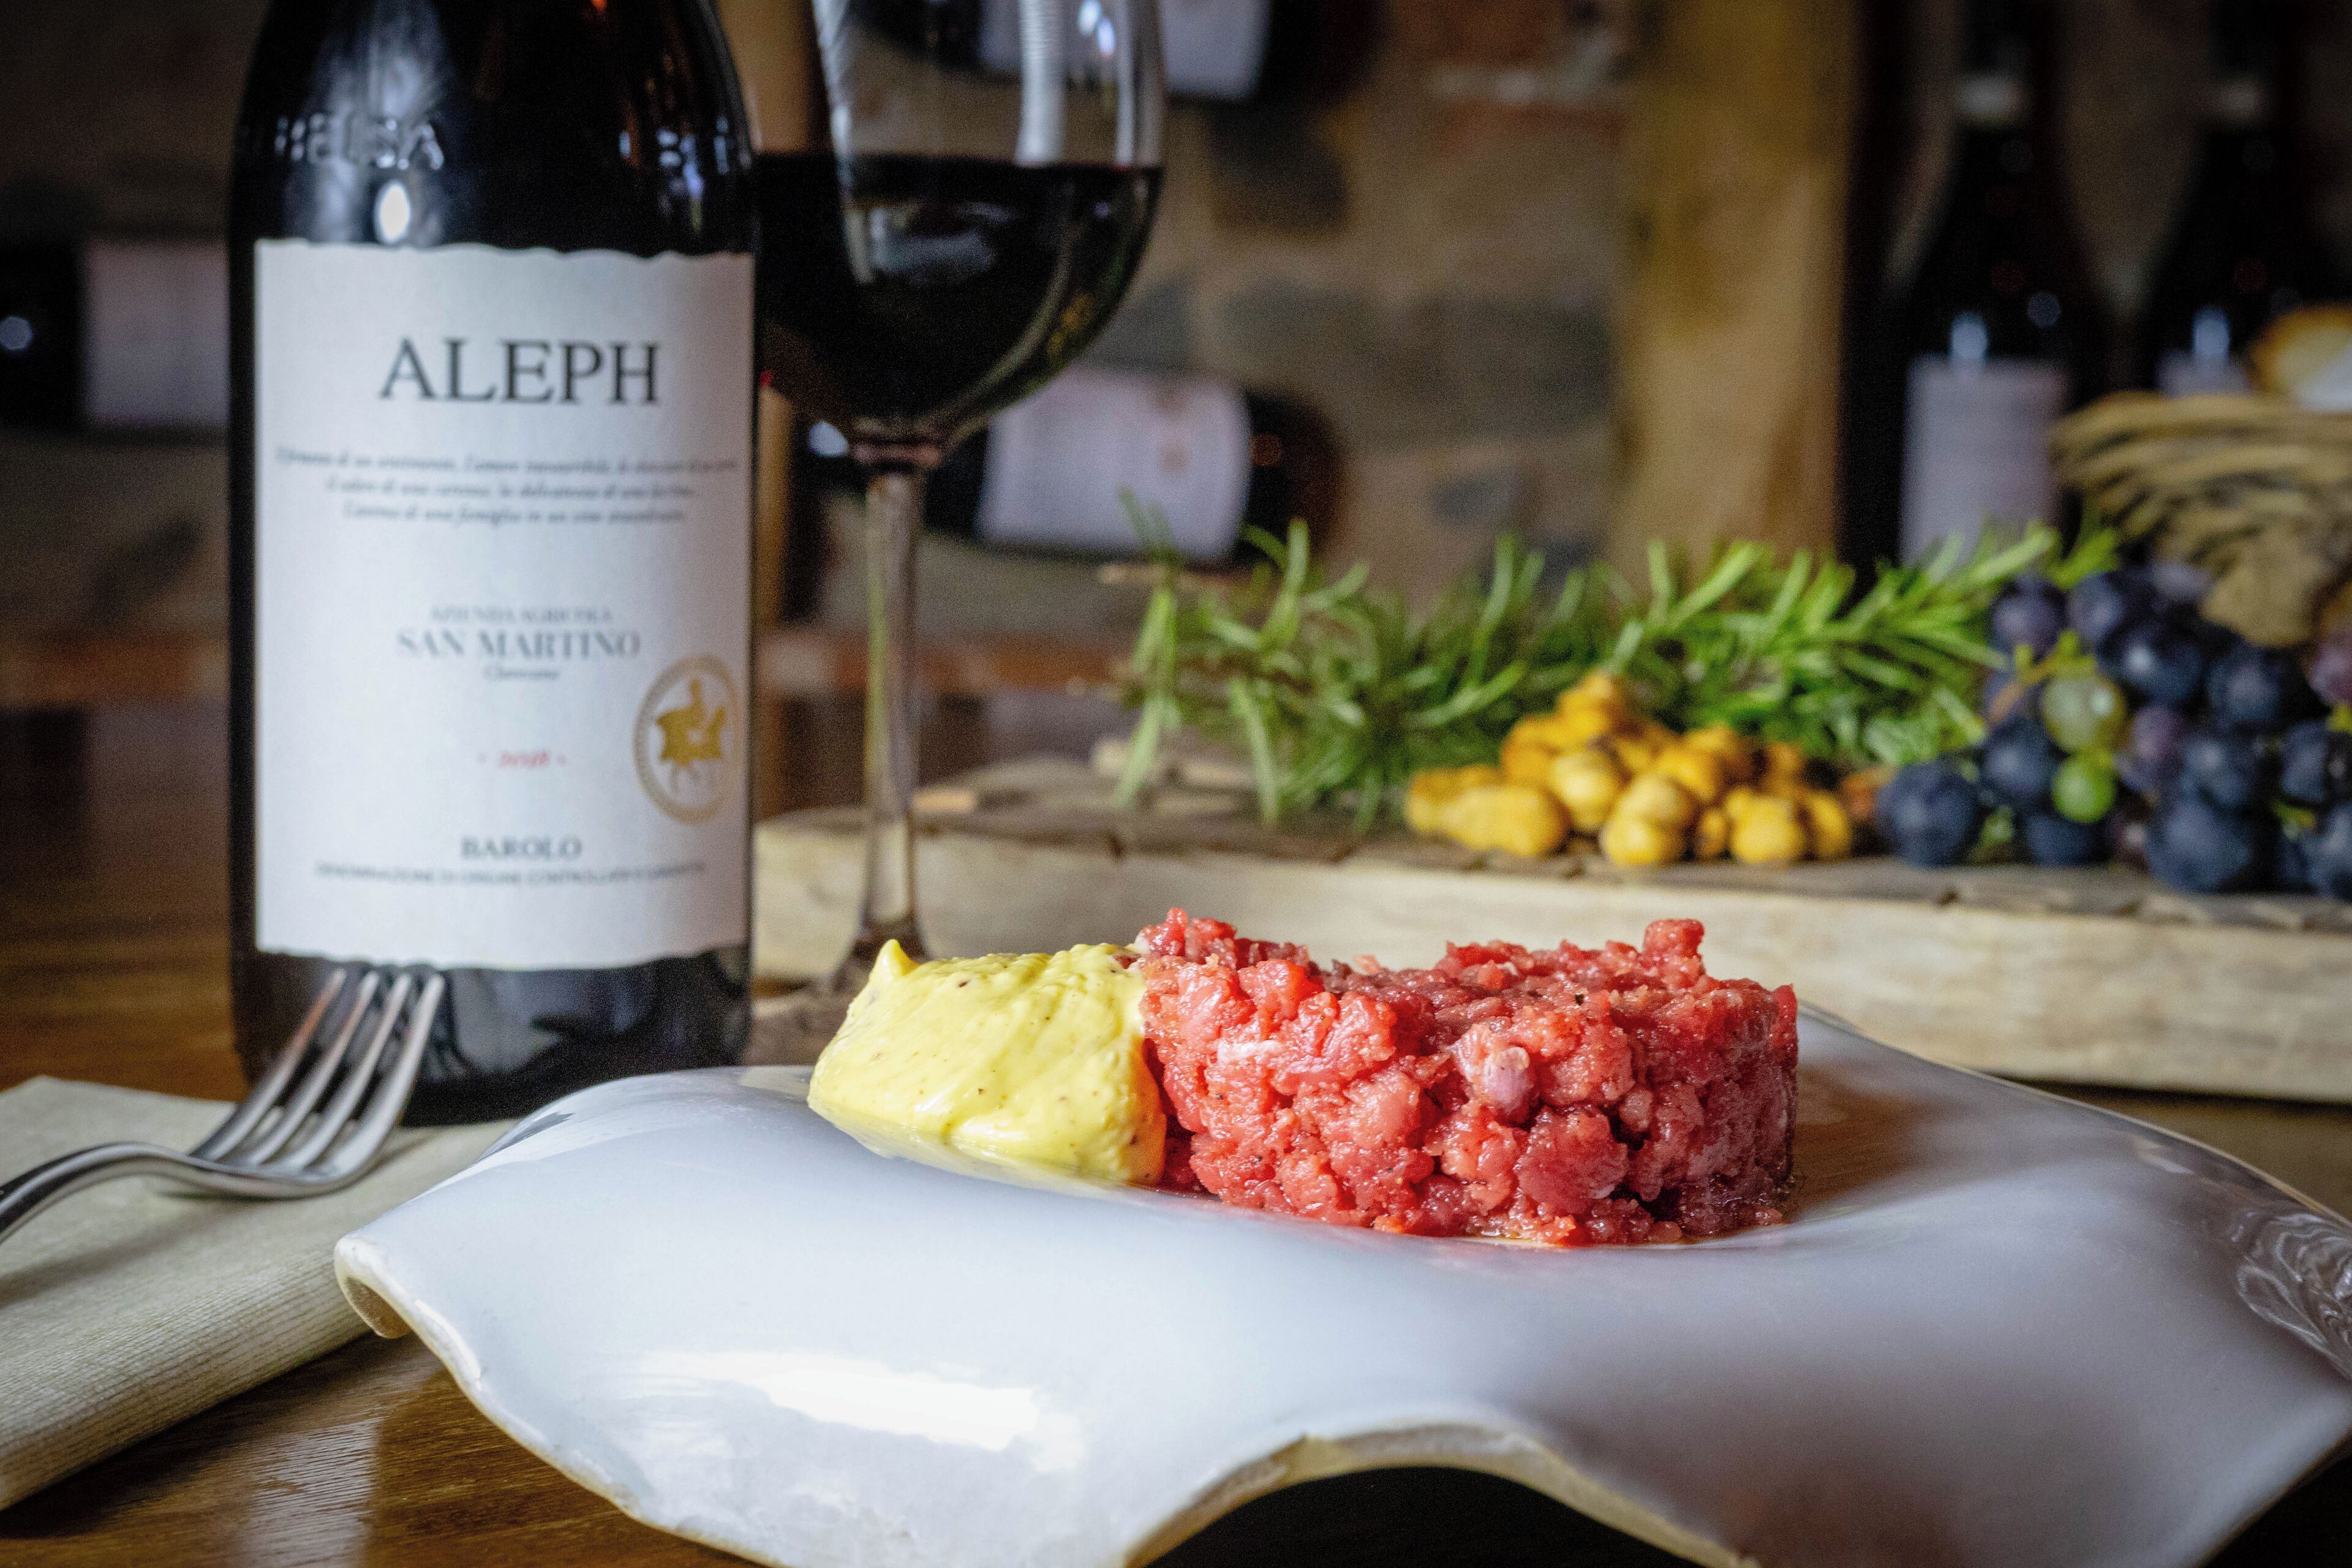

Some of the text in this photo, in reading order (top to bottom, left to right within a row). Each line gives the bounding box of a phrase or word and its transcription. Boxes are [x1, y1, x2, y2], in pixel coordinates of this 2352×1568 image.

[380, 336, 658, 404] ALEPH
[396, 627, 641, 659] SAN MARTINO
[461, 835, 582, 861] BAROLO
